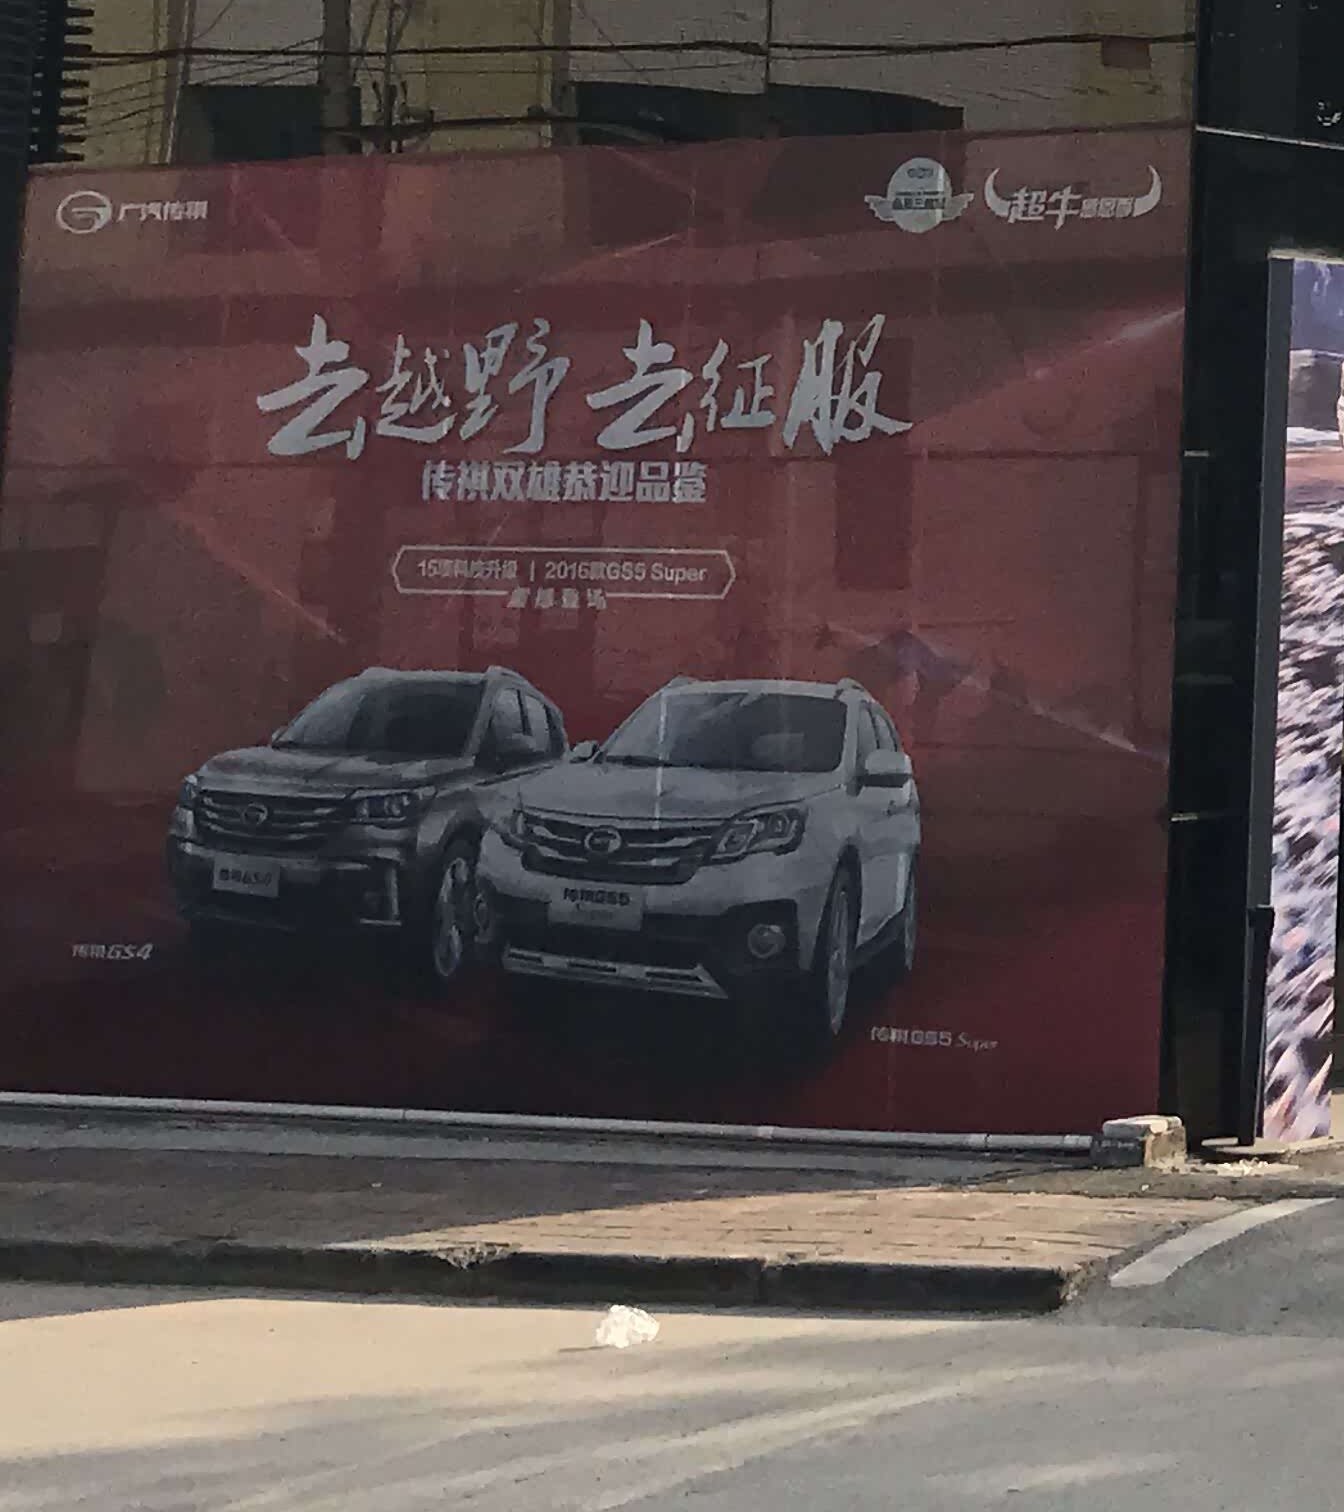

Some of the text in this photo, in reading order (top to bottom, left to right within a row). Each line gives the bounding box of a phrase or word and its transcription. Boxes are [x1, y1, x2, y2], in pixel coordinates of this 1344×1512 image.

[256, 312, 914, 461] 去越野 去征服
[421, 459, 707, 504] 传祺双雄恭迎品鉴
[651, 562, 708, 585] Super
